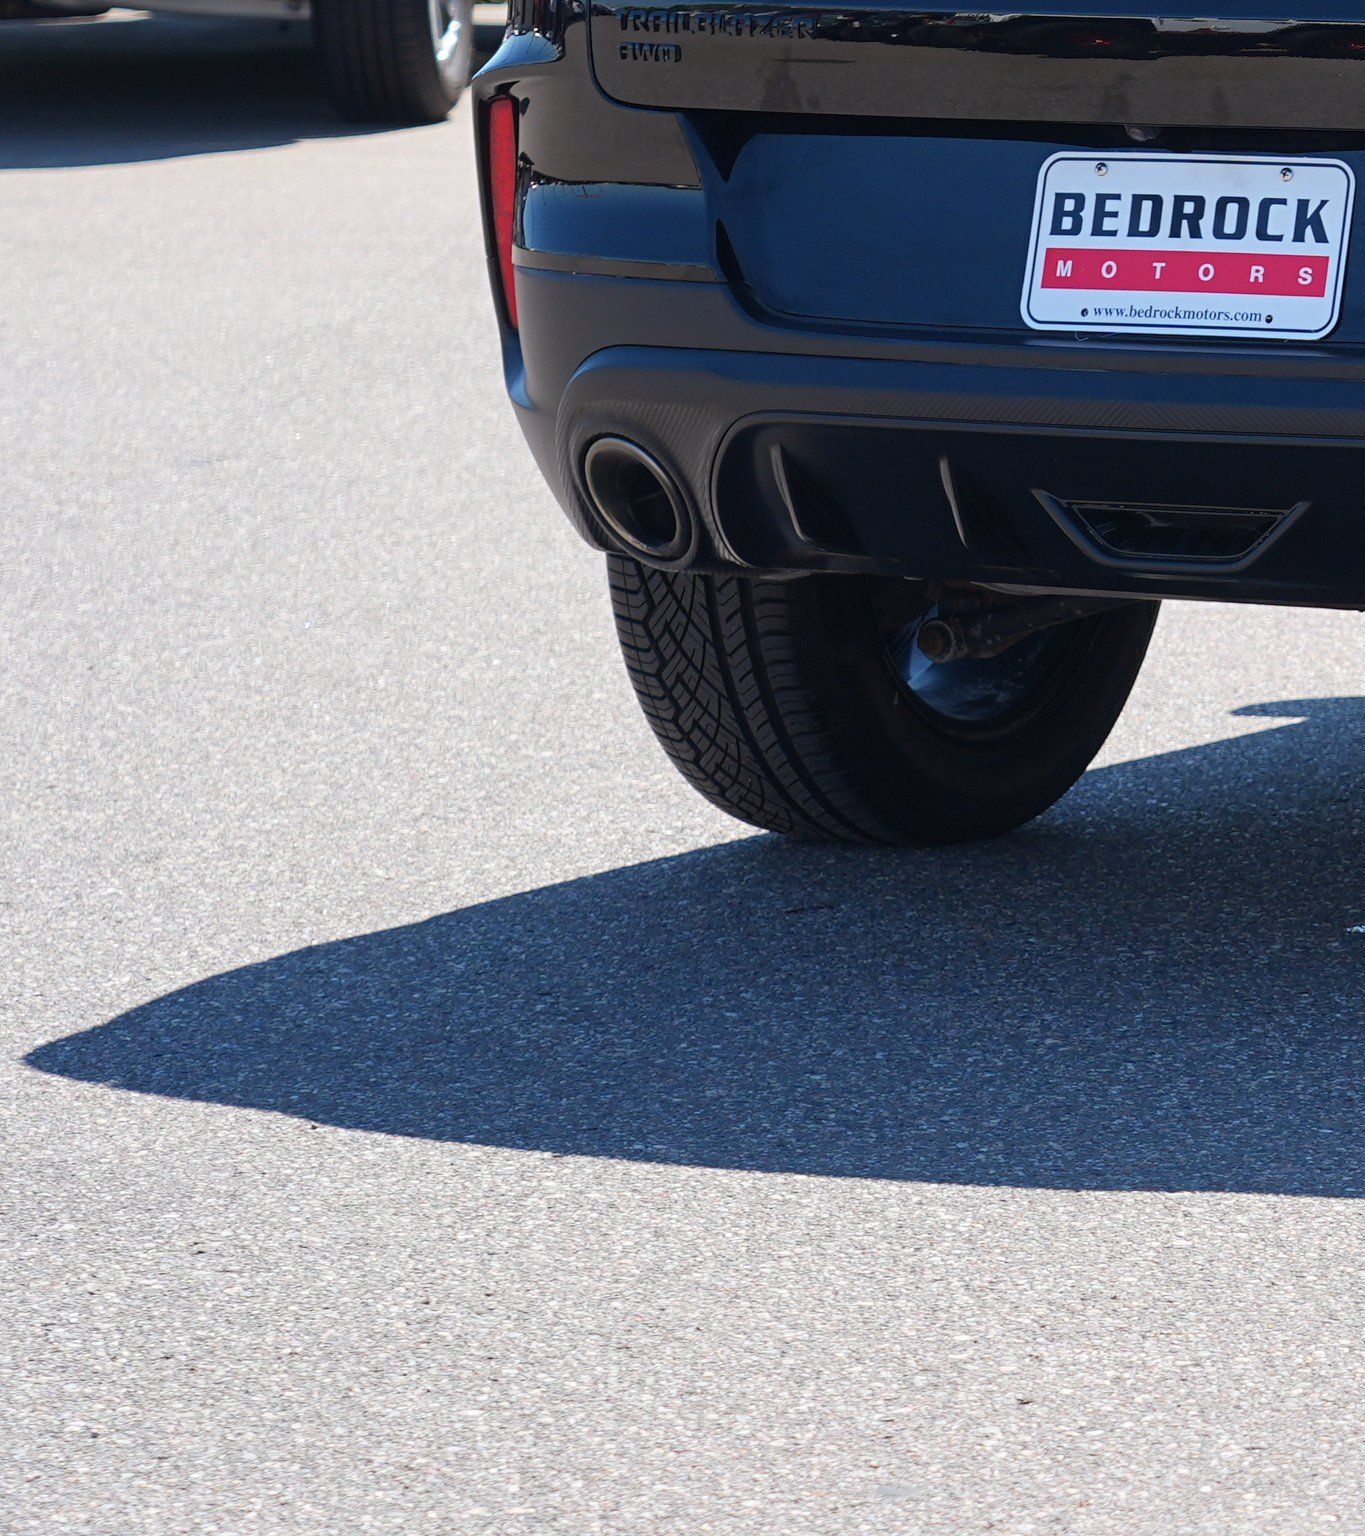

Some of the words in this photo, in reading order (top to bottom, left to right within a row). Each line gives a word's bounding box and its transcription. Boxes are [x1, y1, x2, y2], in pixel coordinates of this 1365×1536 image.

[1049, 192, 1330, 244] BEDROCK
[1055, 260, 1313, 286] MOTORS
[1093, 304, 1263, 324] www.bedrockmotors.com
